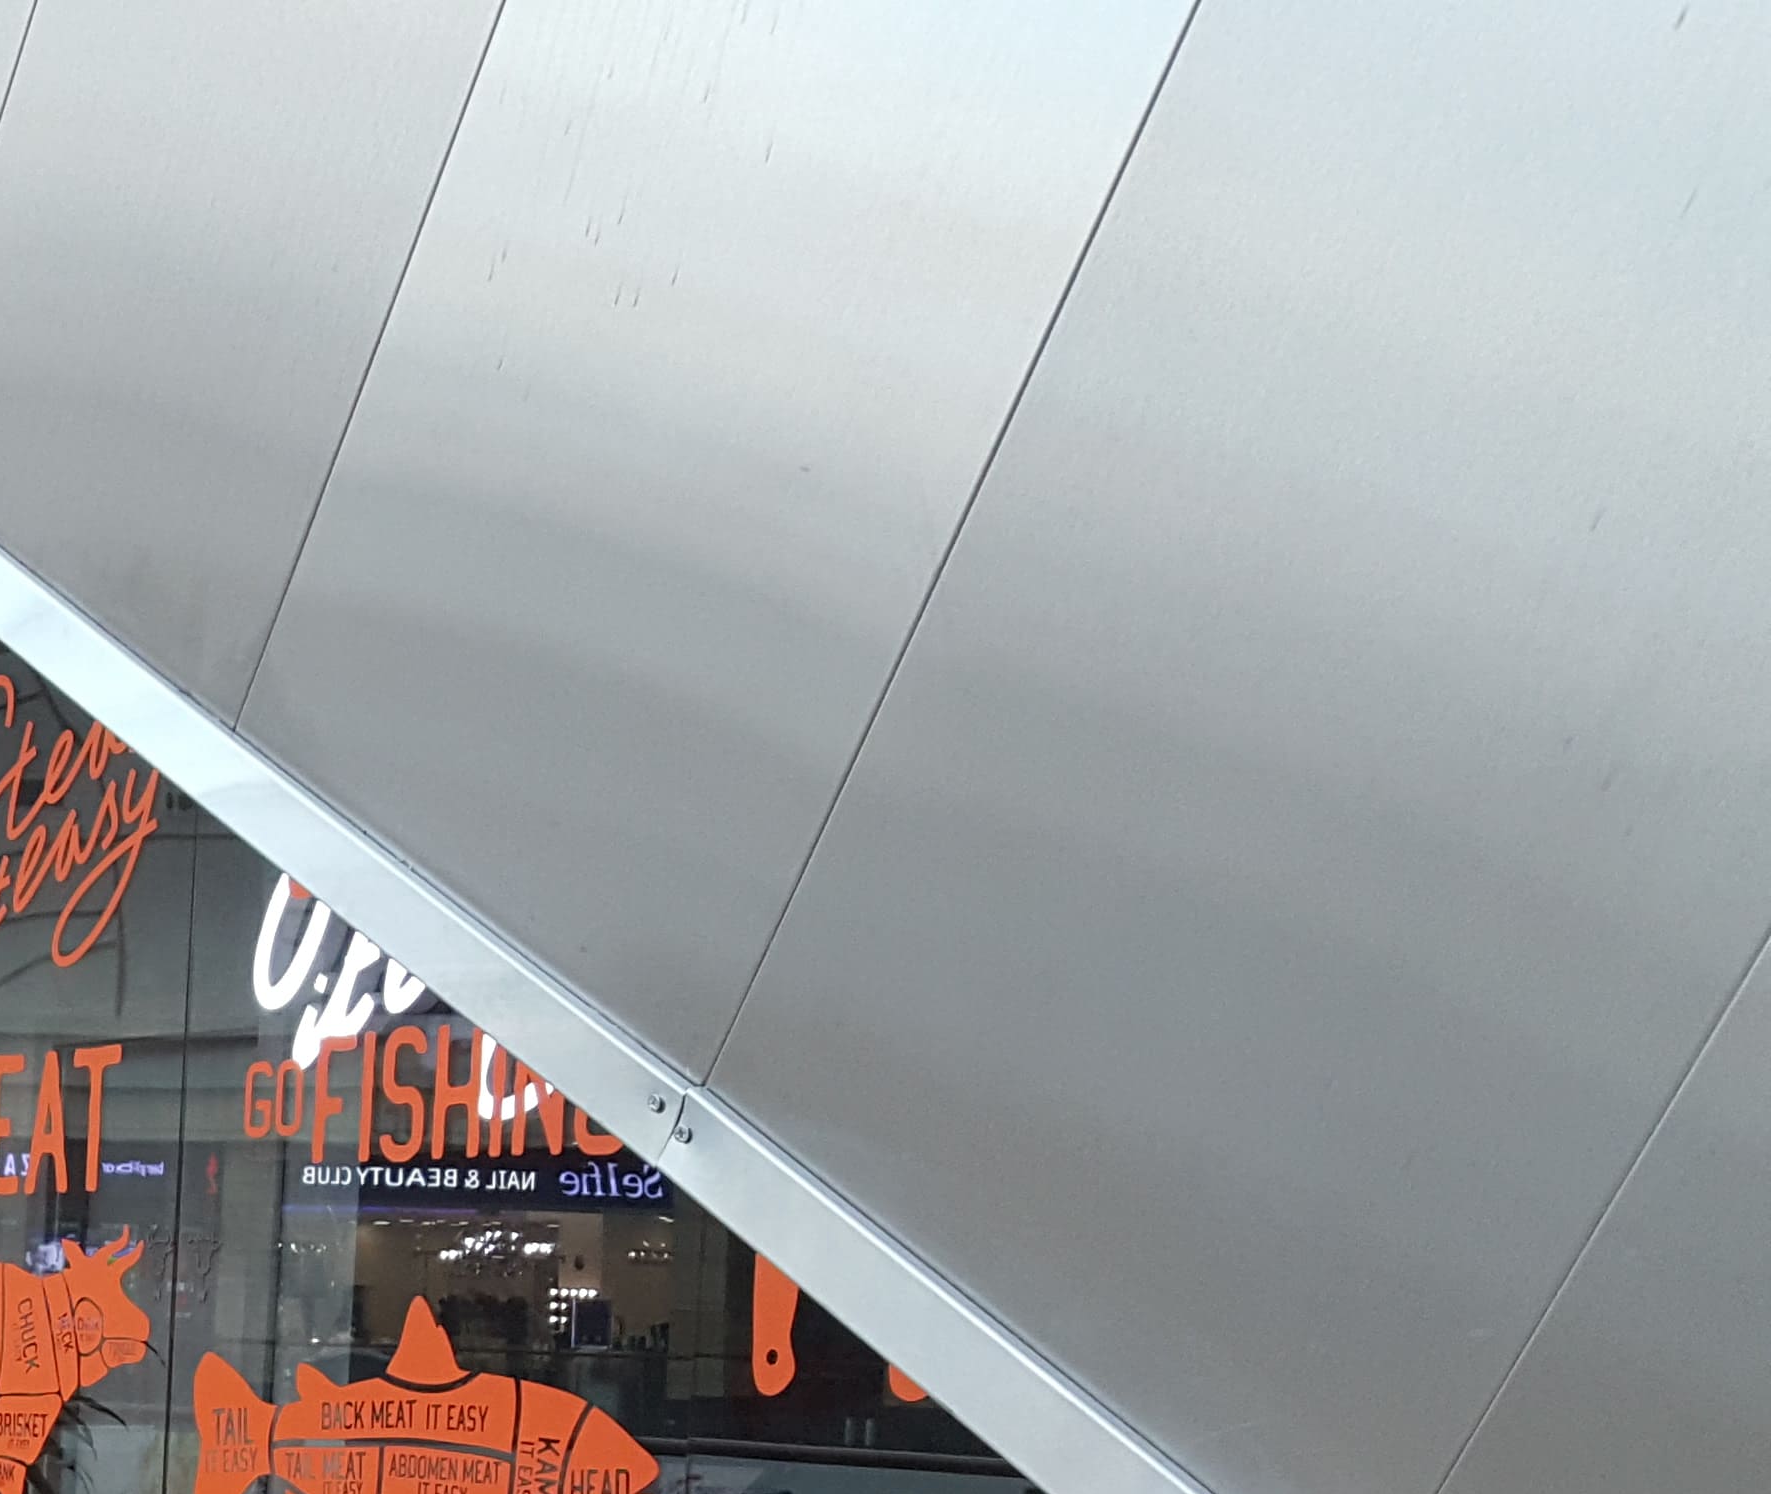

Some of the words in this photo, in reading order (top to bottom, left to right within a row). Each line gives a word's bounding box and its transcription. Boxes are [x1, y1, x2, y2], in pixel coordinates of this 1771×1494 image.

[243, 1060, 305, 1139] GO
[17, 1297, 41, 1375] CHUCK
[213, 1408, 255, 1446] TAIL
[320, 1402, 366, 1431] BACK
[371, 1400, 417, 1430] MEAT
[426, 1401, 442, 1430] IT
[446, 1404, 490, 1434] EASY
[285, 1452, 316, 1480] TAIL
[321, 1450, 367, 1481] MEAT
[388, 1453, 459, 1484] ABDOMEN
[462, 1456, 501, 1486] MEAT
